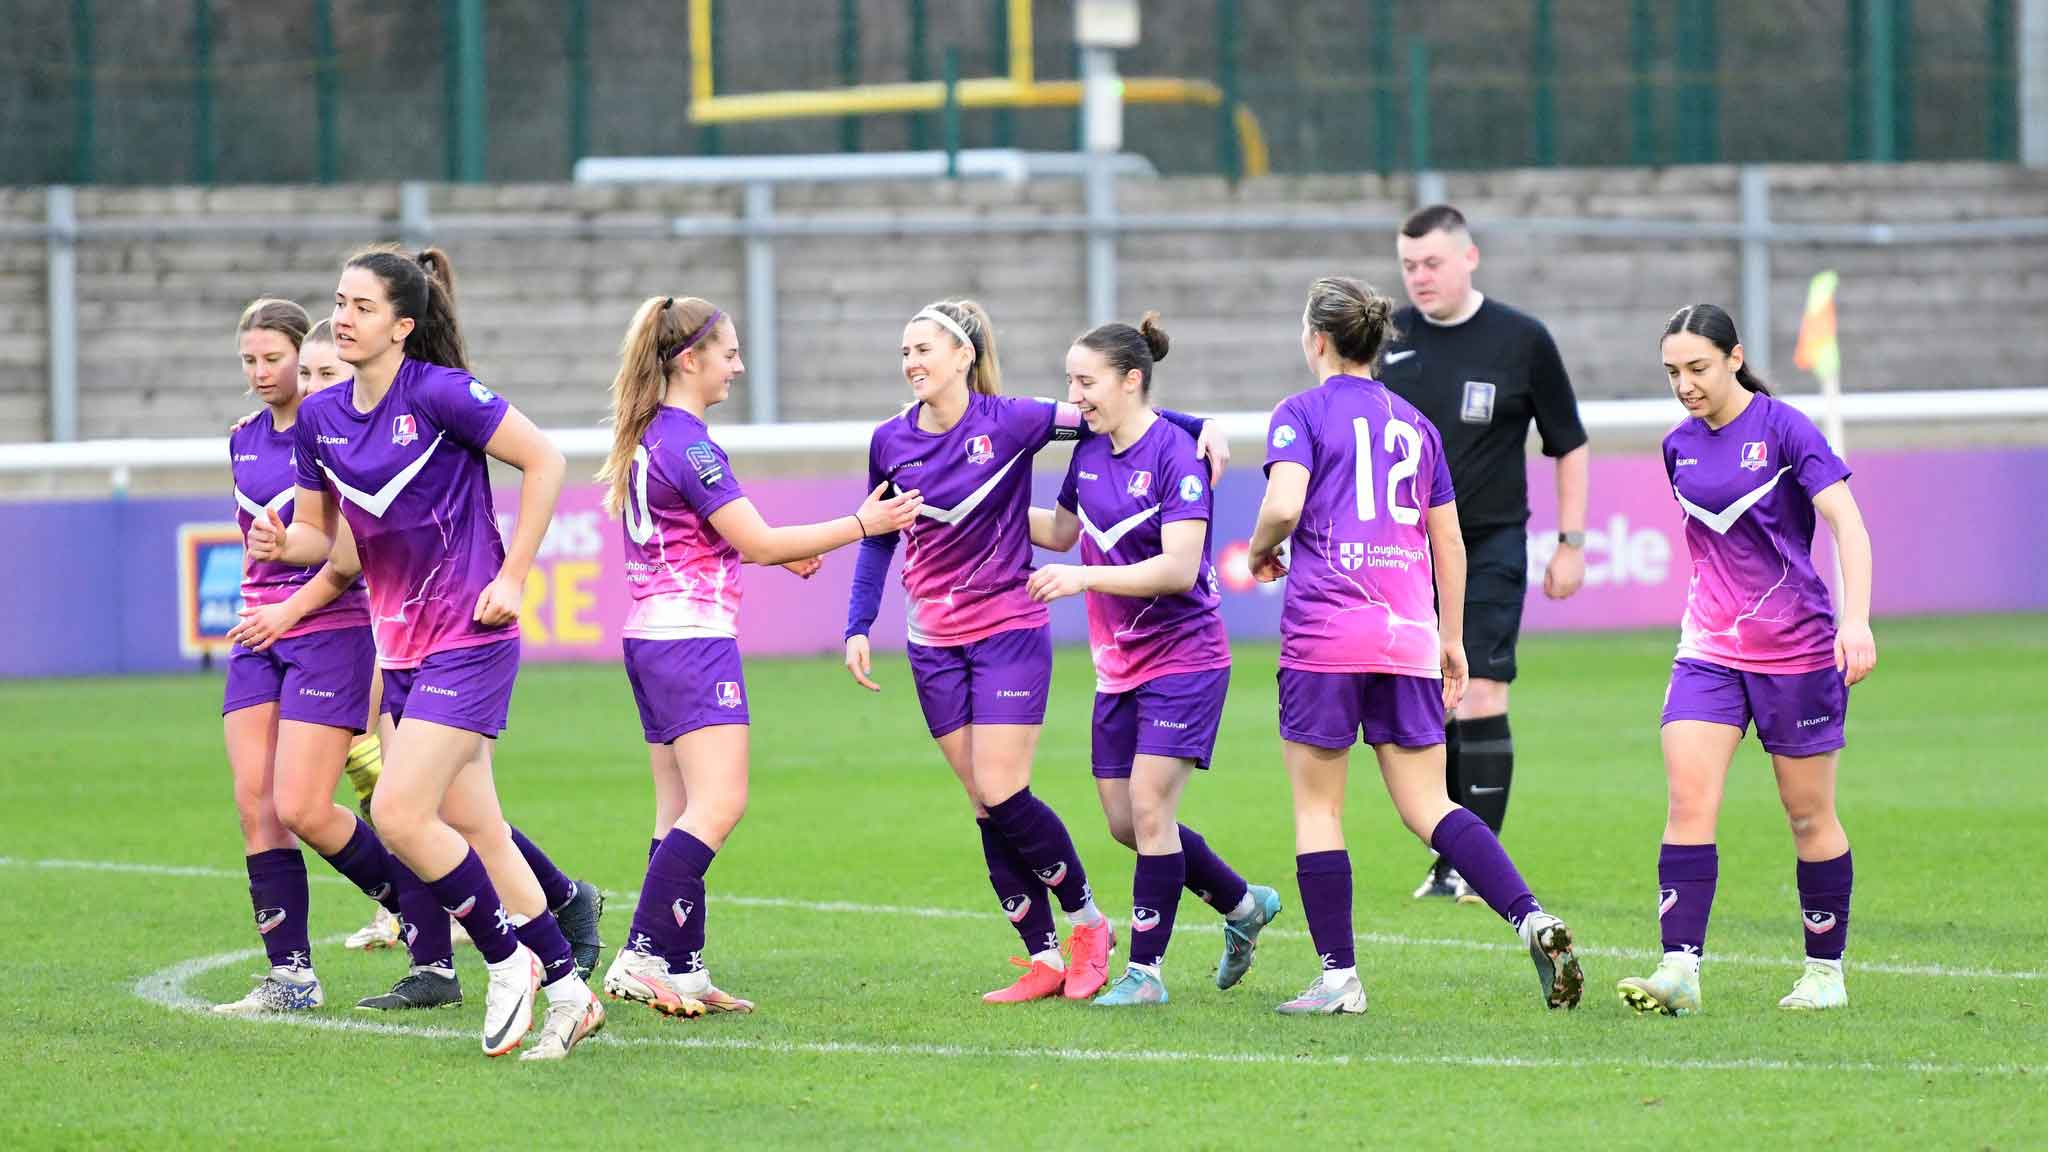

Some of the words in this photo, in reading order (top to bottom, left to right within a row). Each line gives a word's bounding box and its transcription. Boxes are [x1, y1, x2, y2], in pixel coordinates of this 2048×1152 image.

[1353, 416, 1421, 525] 12
[306, 688, 335, 697] KUKRI
[426, 685, 458, 697] KUKRI
[1803, 715, 1829, 727] KUKRI
